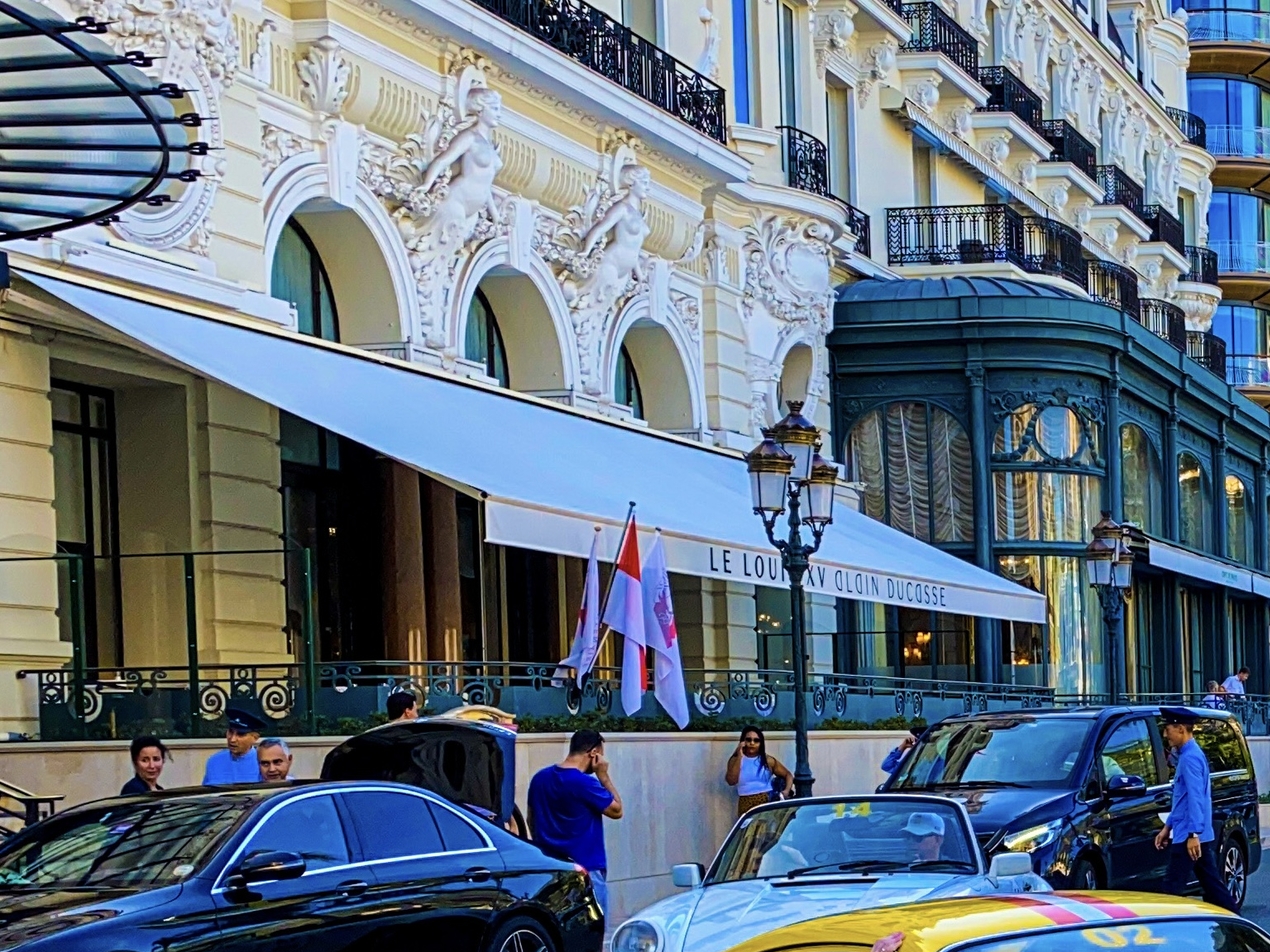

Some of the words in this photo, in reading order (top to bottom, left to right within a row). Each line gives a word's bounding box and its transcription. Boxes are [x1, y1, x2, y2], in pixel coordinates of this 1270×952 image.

[709, 547, 732, 574] LE
[743, 552, 786, 583] LOUI
[806, 565, 826, 589] XV
